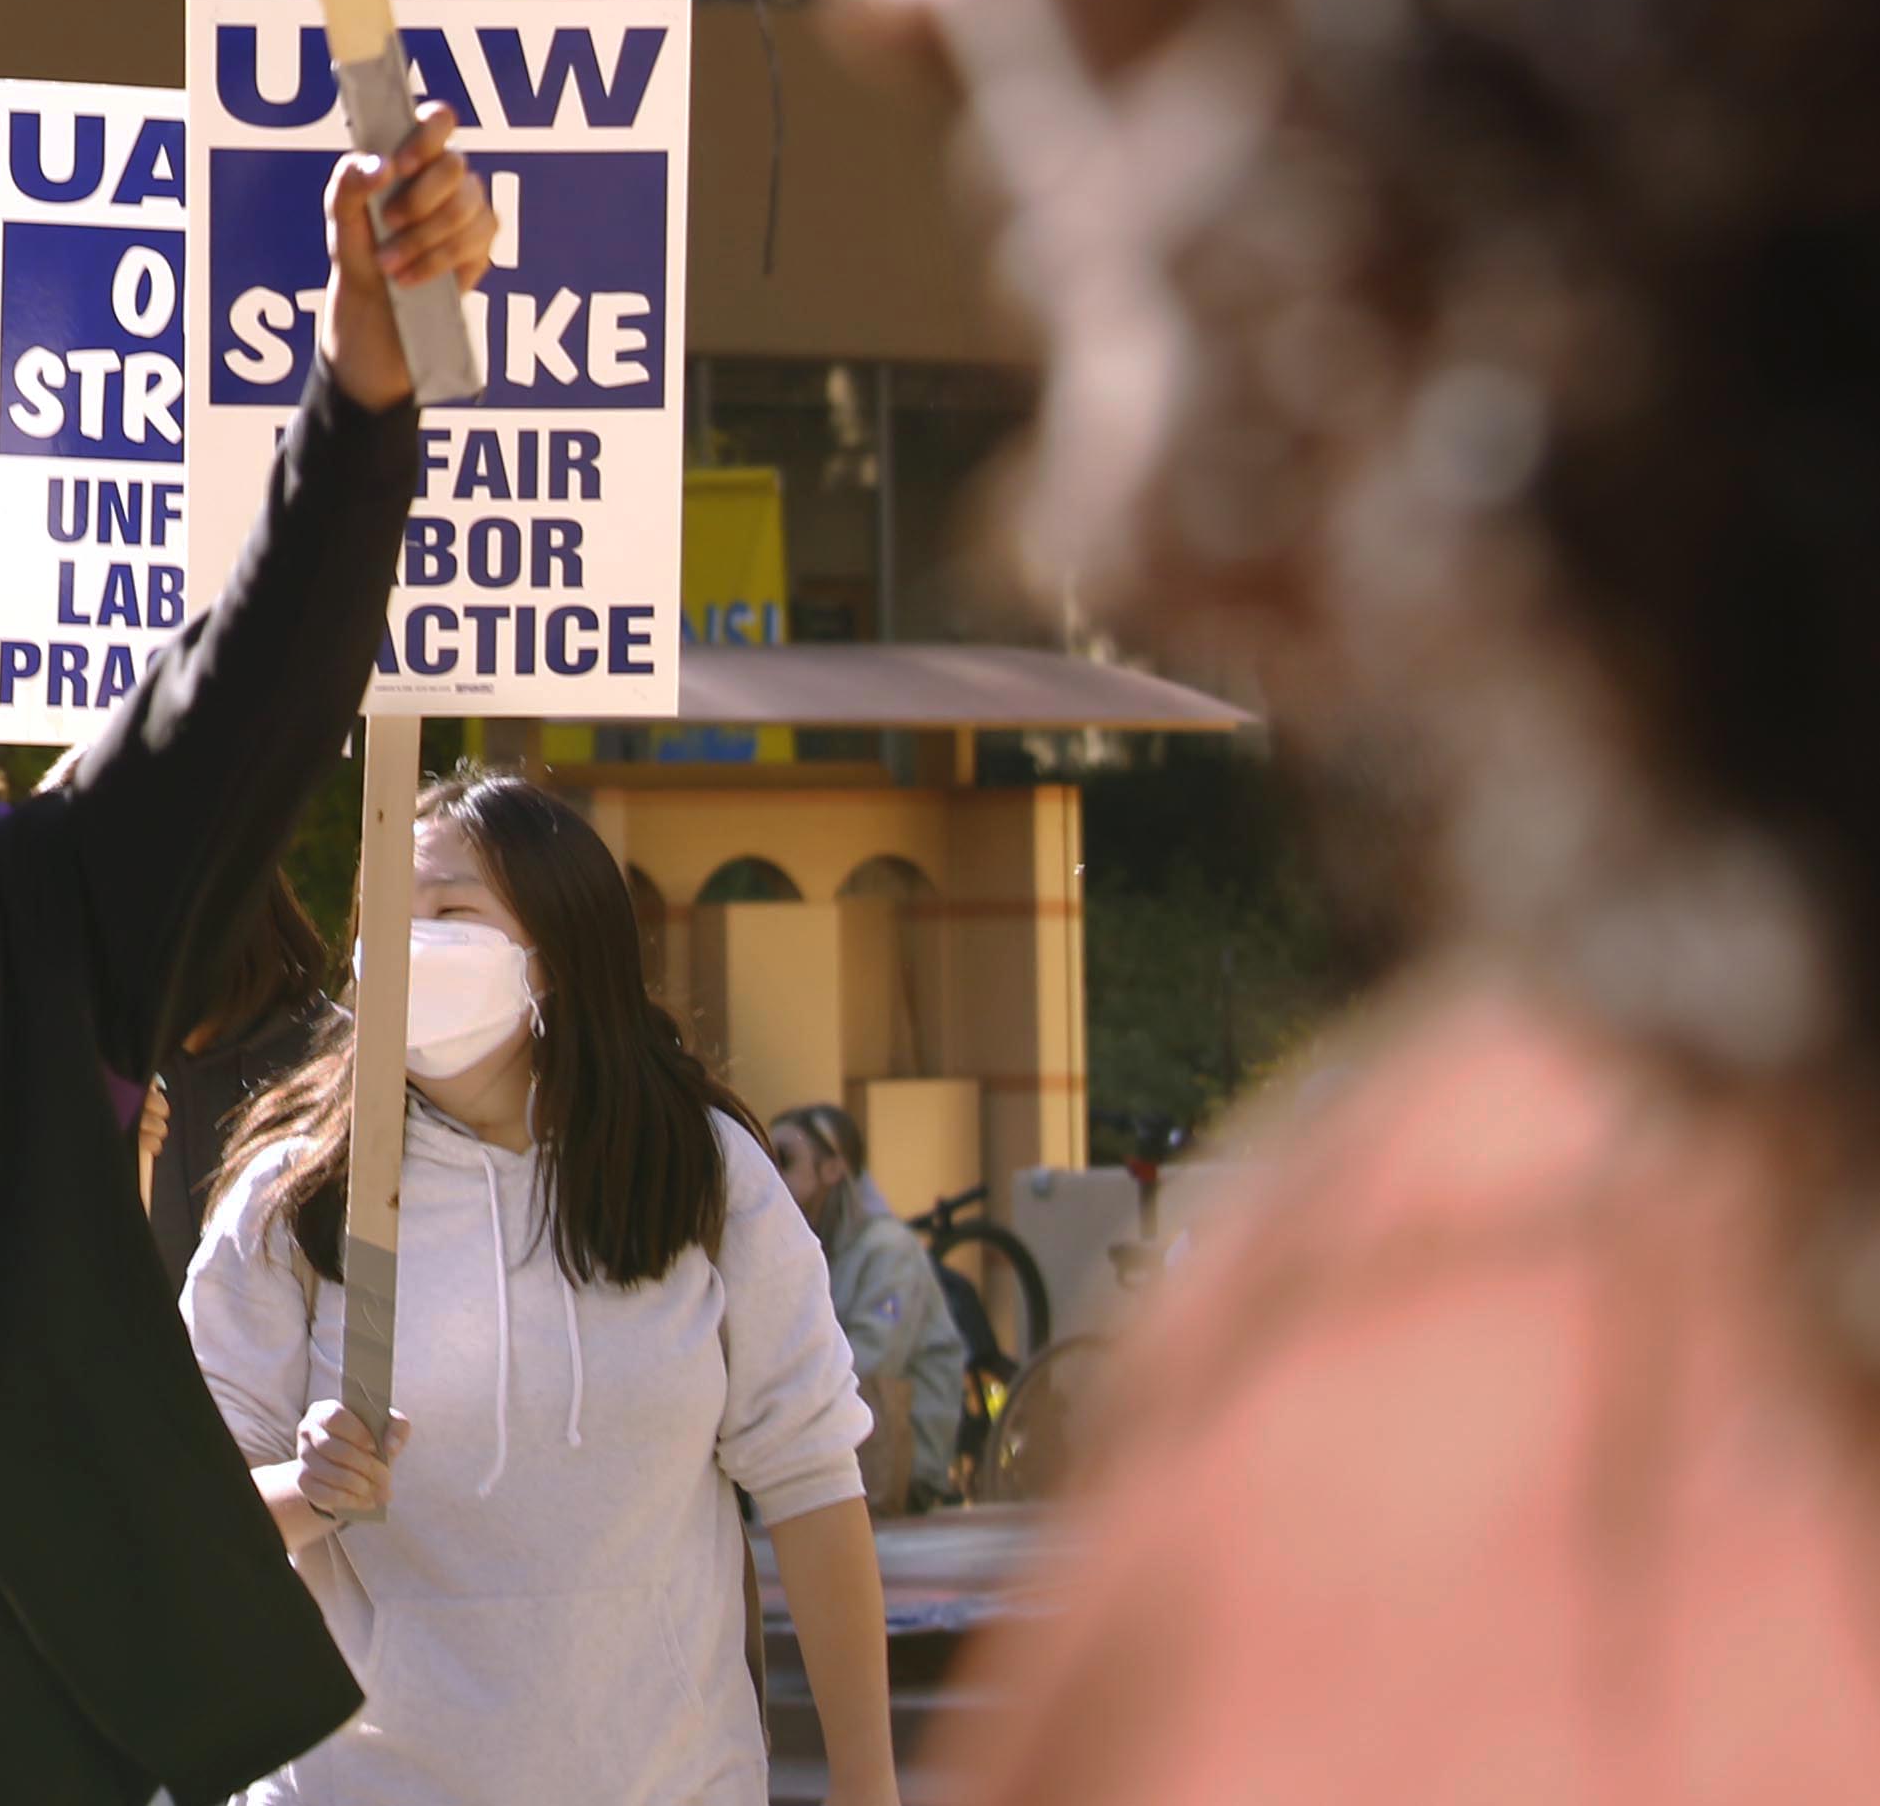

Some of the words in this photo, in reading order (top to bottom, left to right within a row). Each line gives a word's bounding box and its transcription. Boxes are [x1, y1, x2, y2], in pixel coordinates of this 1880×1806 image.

[216, 25, 668, 129] UAW
[9, 112, 185, 206] UA
[113, 247, 176, 338] O
[9, 347, 184, 444] STR
[47, 478, 184, 546] UNF
[392, 516, 585, 588] BOR
[57, 560, 184, 628] LAB
[374, 605, 655, 675] CTICE
